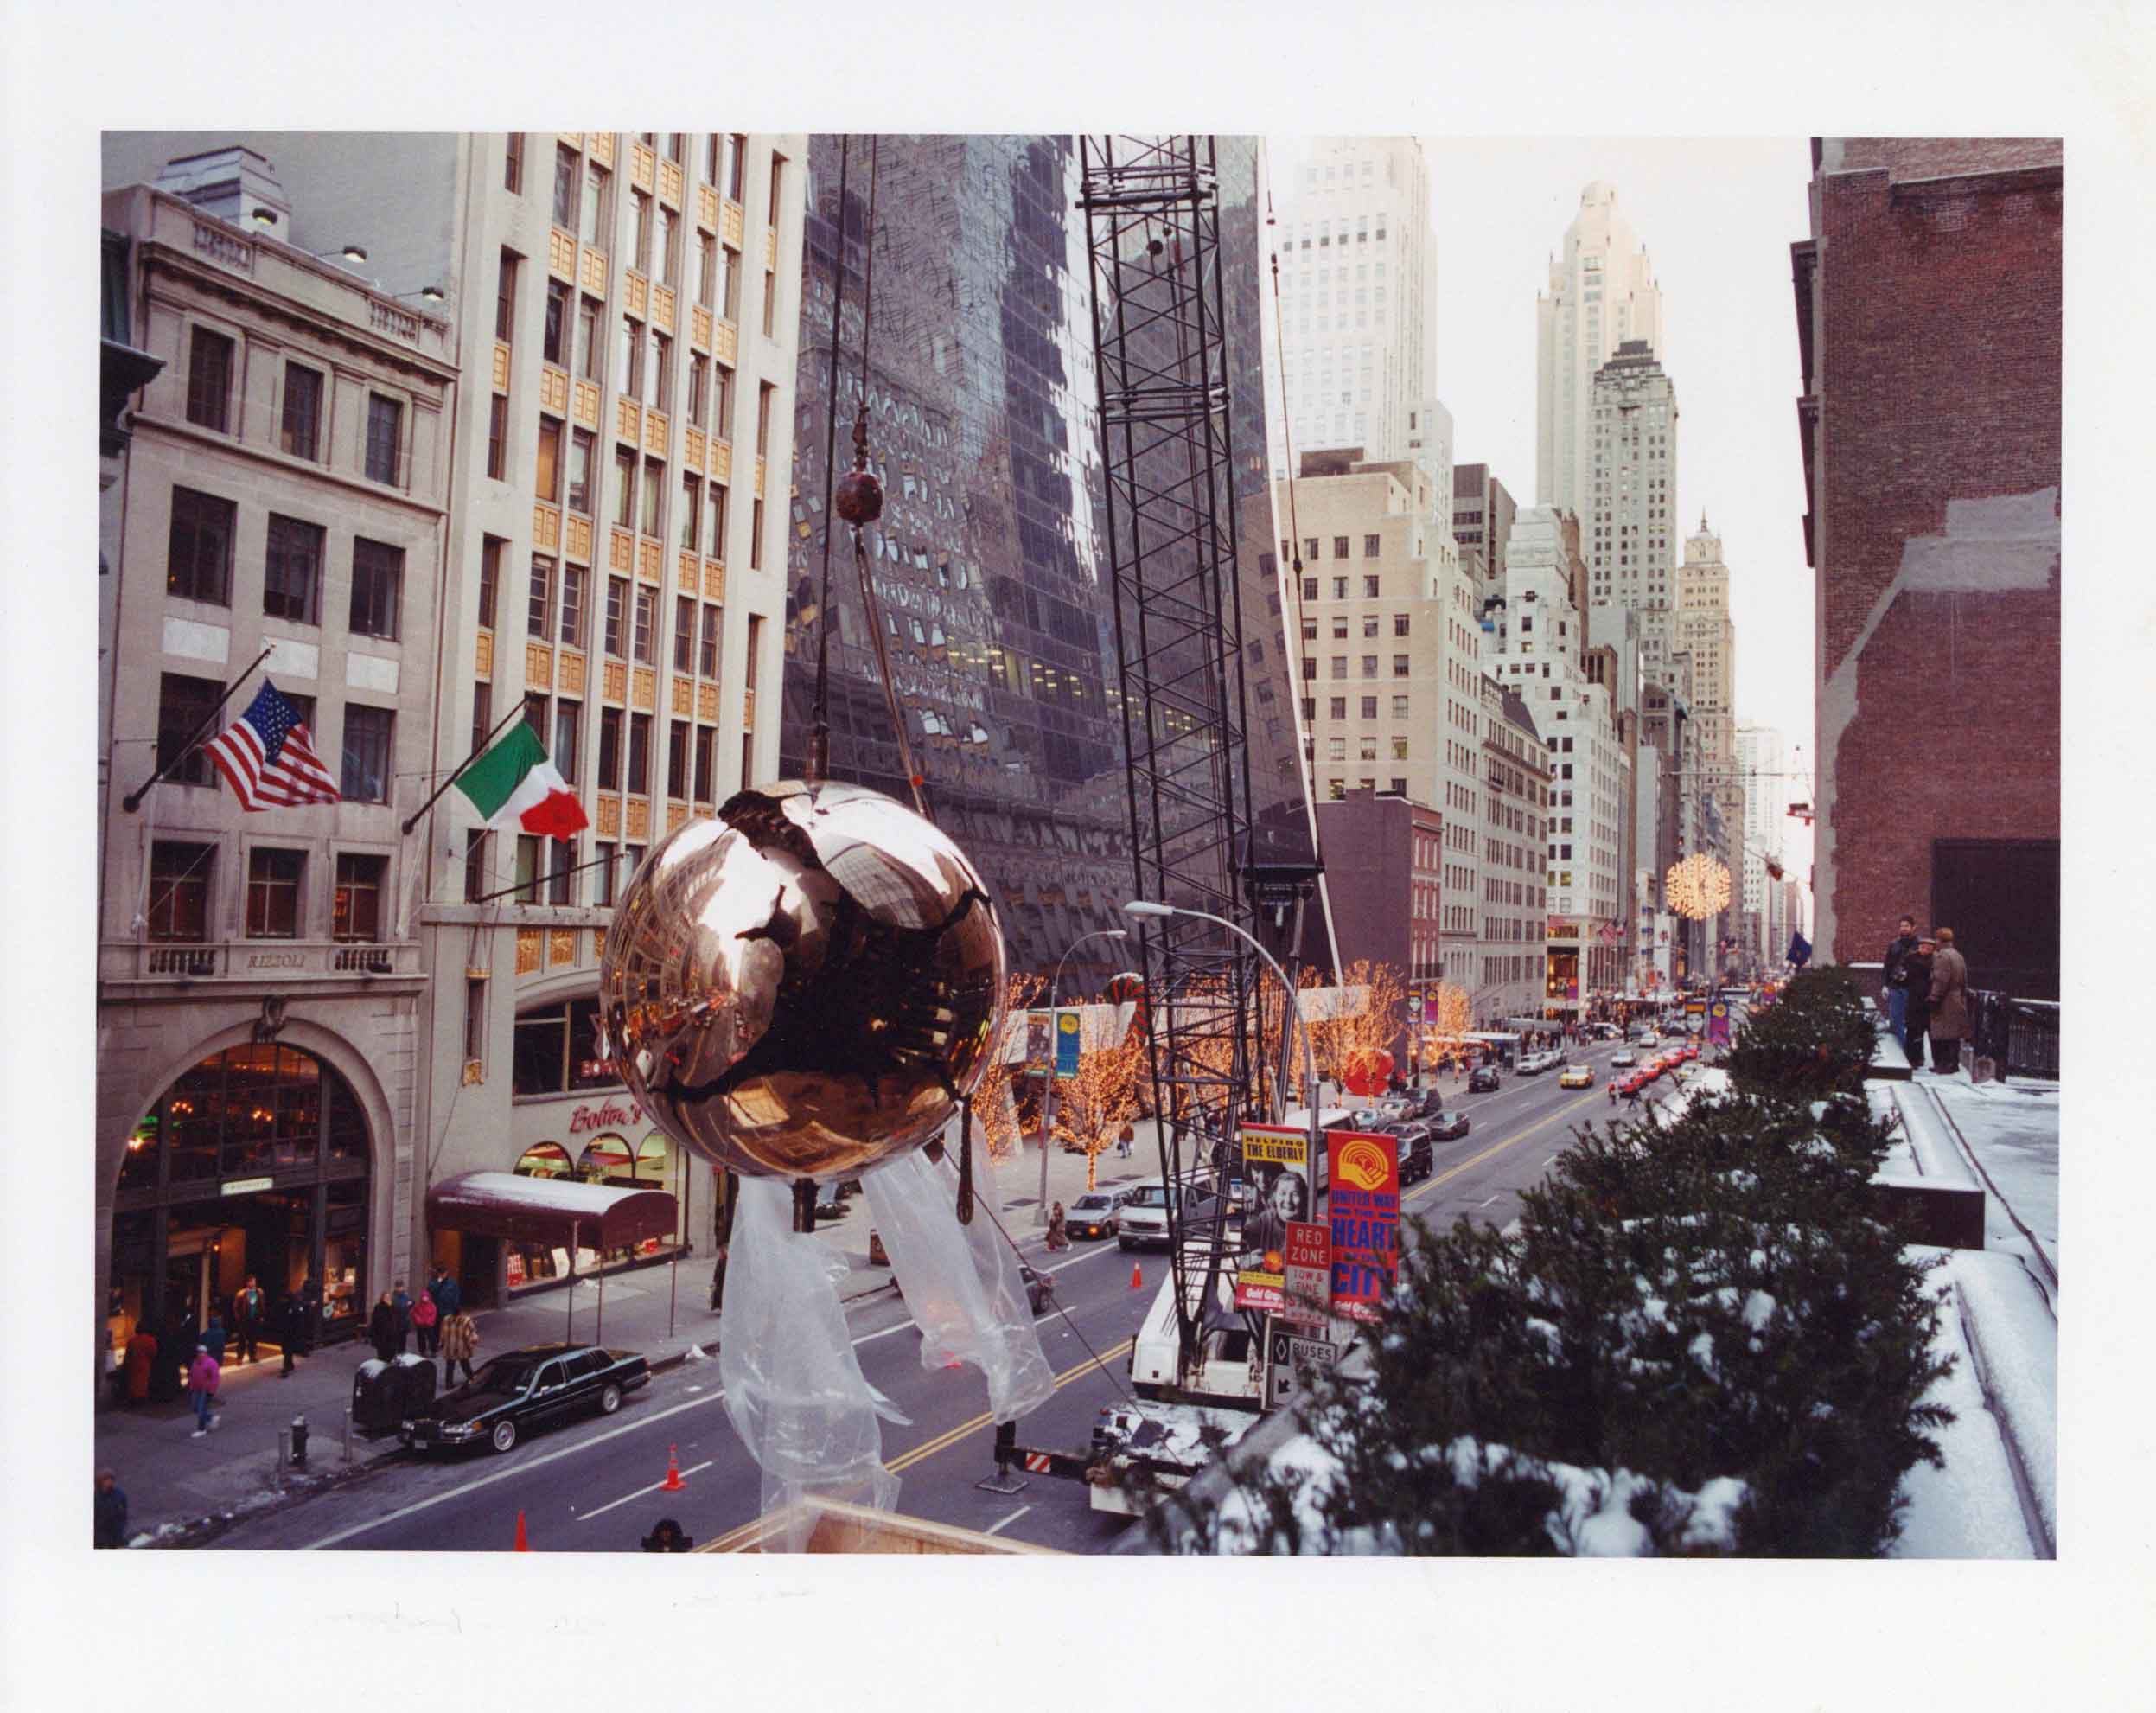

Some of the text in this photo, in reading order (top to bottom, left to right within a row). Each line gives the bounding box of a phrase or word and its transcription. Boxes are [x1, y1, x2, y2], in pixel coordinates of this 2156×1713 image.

[1247, 1144, 1304, 1160] THE ELDERLY
[1332, 1190, 1397, 1208] UNITED WAY
[1297, 1229, 1322, 1245] RED
[1332, 1218, 1396, 1250] HEART
[1292, 1246, 1327, 1265] ZONE
[1294, 1269, 1313, 1281] TOW
[1292, 1342, 1332, 1360] BUSES
